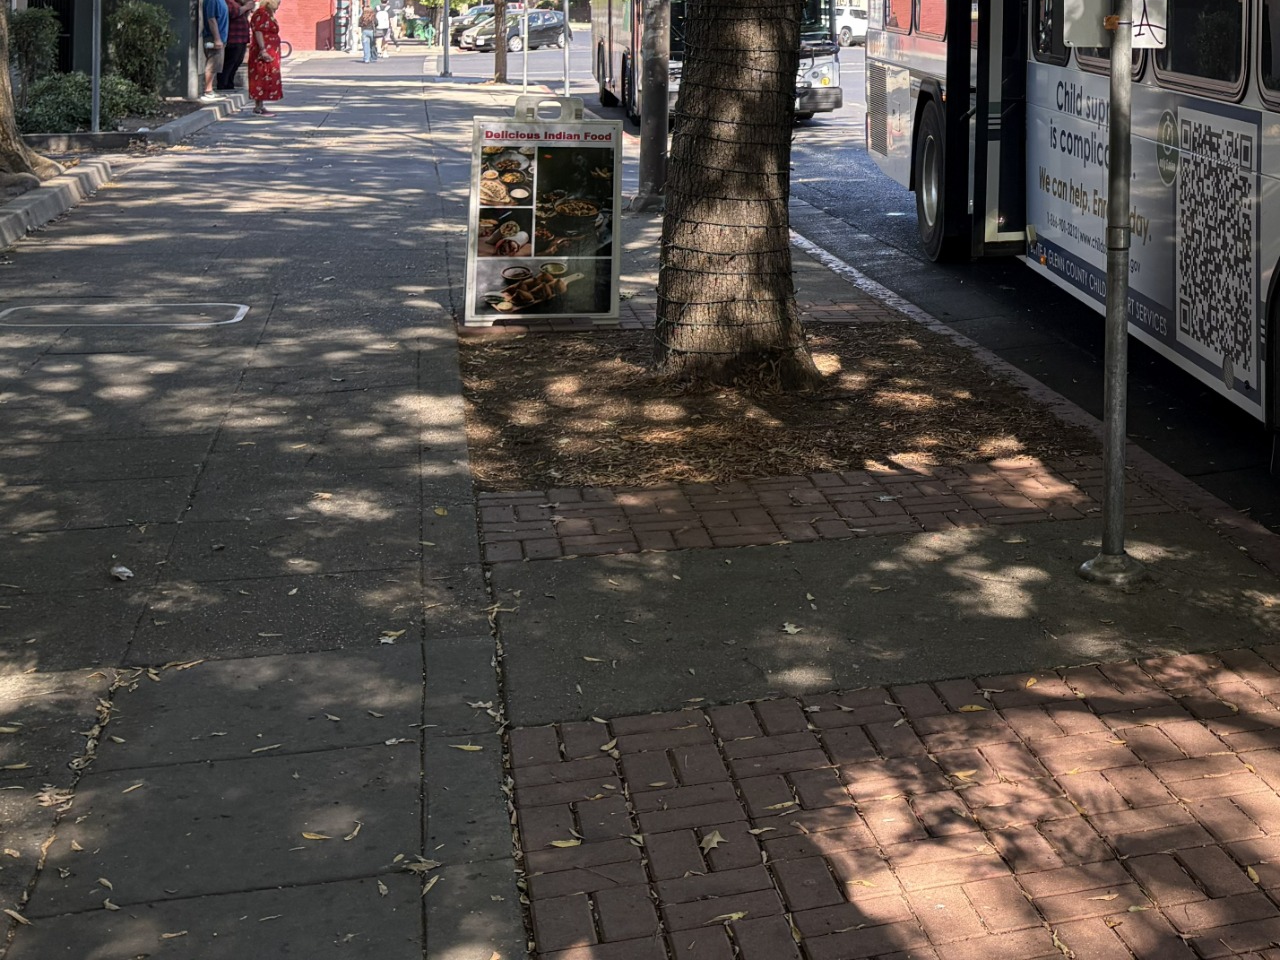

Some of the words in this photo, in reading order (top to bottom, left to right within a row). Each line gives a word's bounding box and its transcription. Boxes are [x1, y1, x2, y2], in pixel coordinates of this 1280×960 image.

[1056, 80, 1083, 116] Child
[485, 130, 541, 140] Delicious
[543, 131, 581, 140] Indian
[583, 132, 612, 141] Food
[1050, 117, 1057, 150] is
[1039, 165, 1050, 193] We
[1052, 177, 1067, 202] can
[1069, 178, 1090, 216] help.
[1048, 250, 1065, 272] GLENN
[1066, 260, 1089, 286] COUNTY
[1089, 274, 1107, 298] CHILD
[1135, 301, 1168, 337] SERVICES
